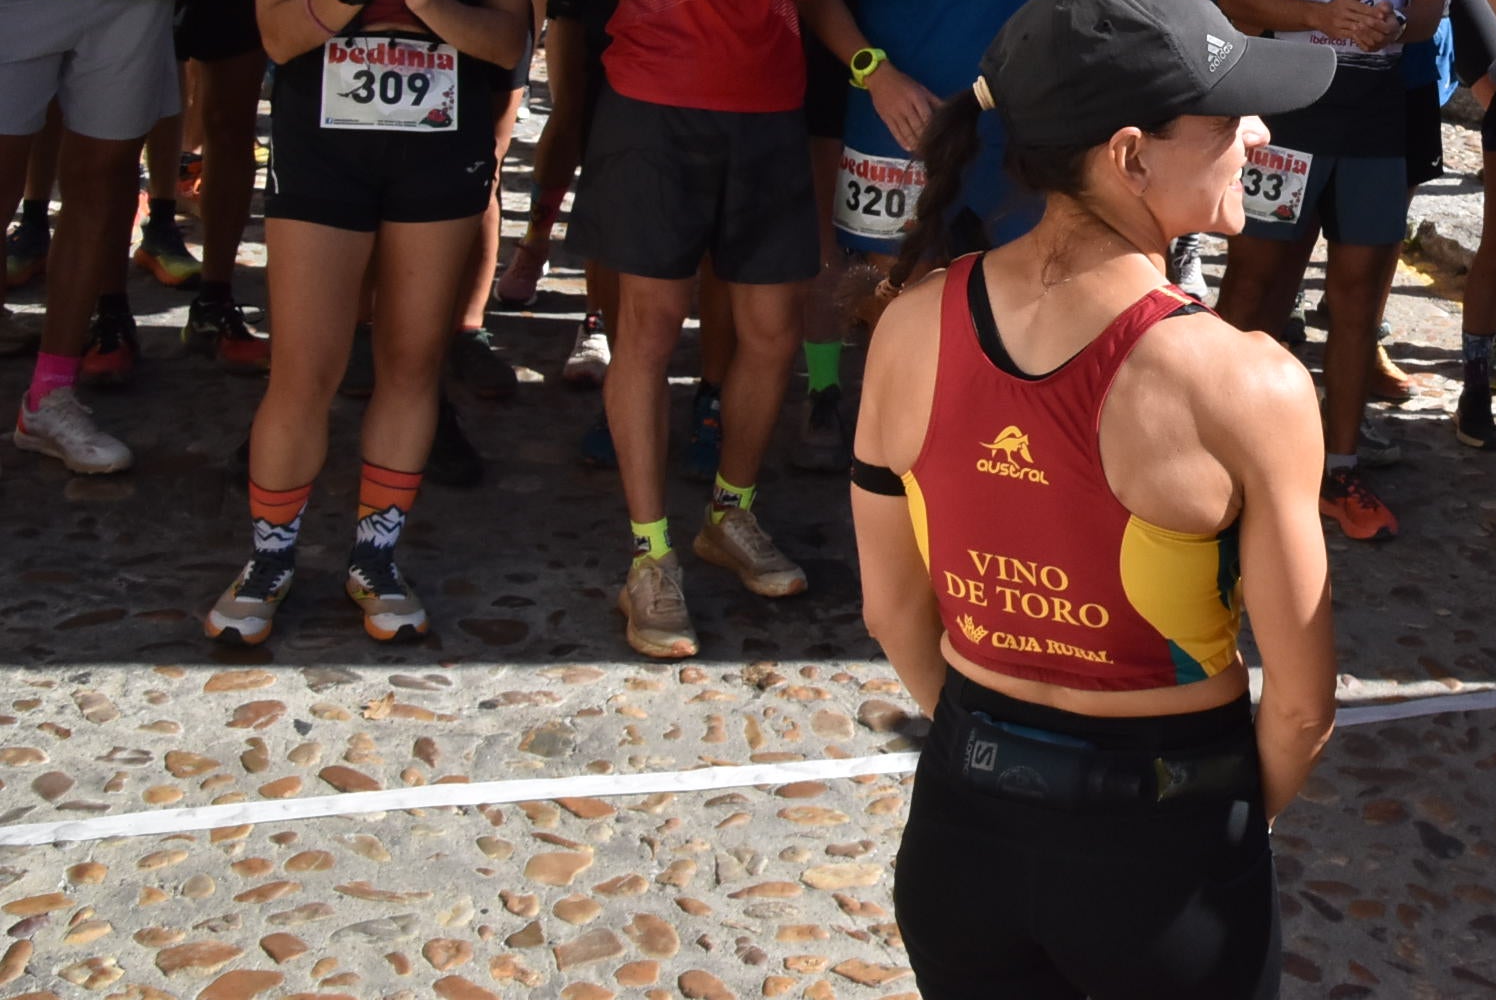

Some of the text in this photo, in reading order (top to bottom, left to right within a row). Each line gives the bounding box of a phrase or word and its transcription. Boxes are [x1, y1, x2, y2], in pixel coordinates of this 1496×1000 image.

[328, 43, 454, 70] bedunia
[351, 70, 431, 106] 309
[1247, 148, 1308, 176] unia
[846, 180, 906, 218] 320
[1241, 167, 1284, 201] 33
[976, 458, 1050, 486] austral
[967, 549, 1070, 593] VINO
[943, 570, 1110, 629] DE TORO
[991, 631, 1114, 664] CAJA RURAL
